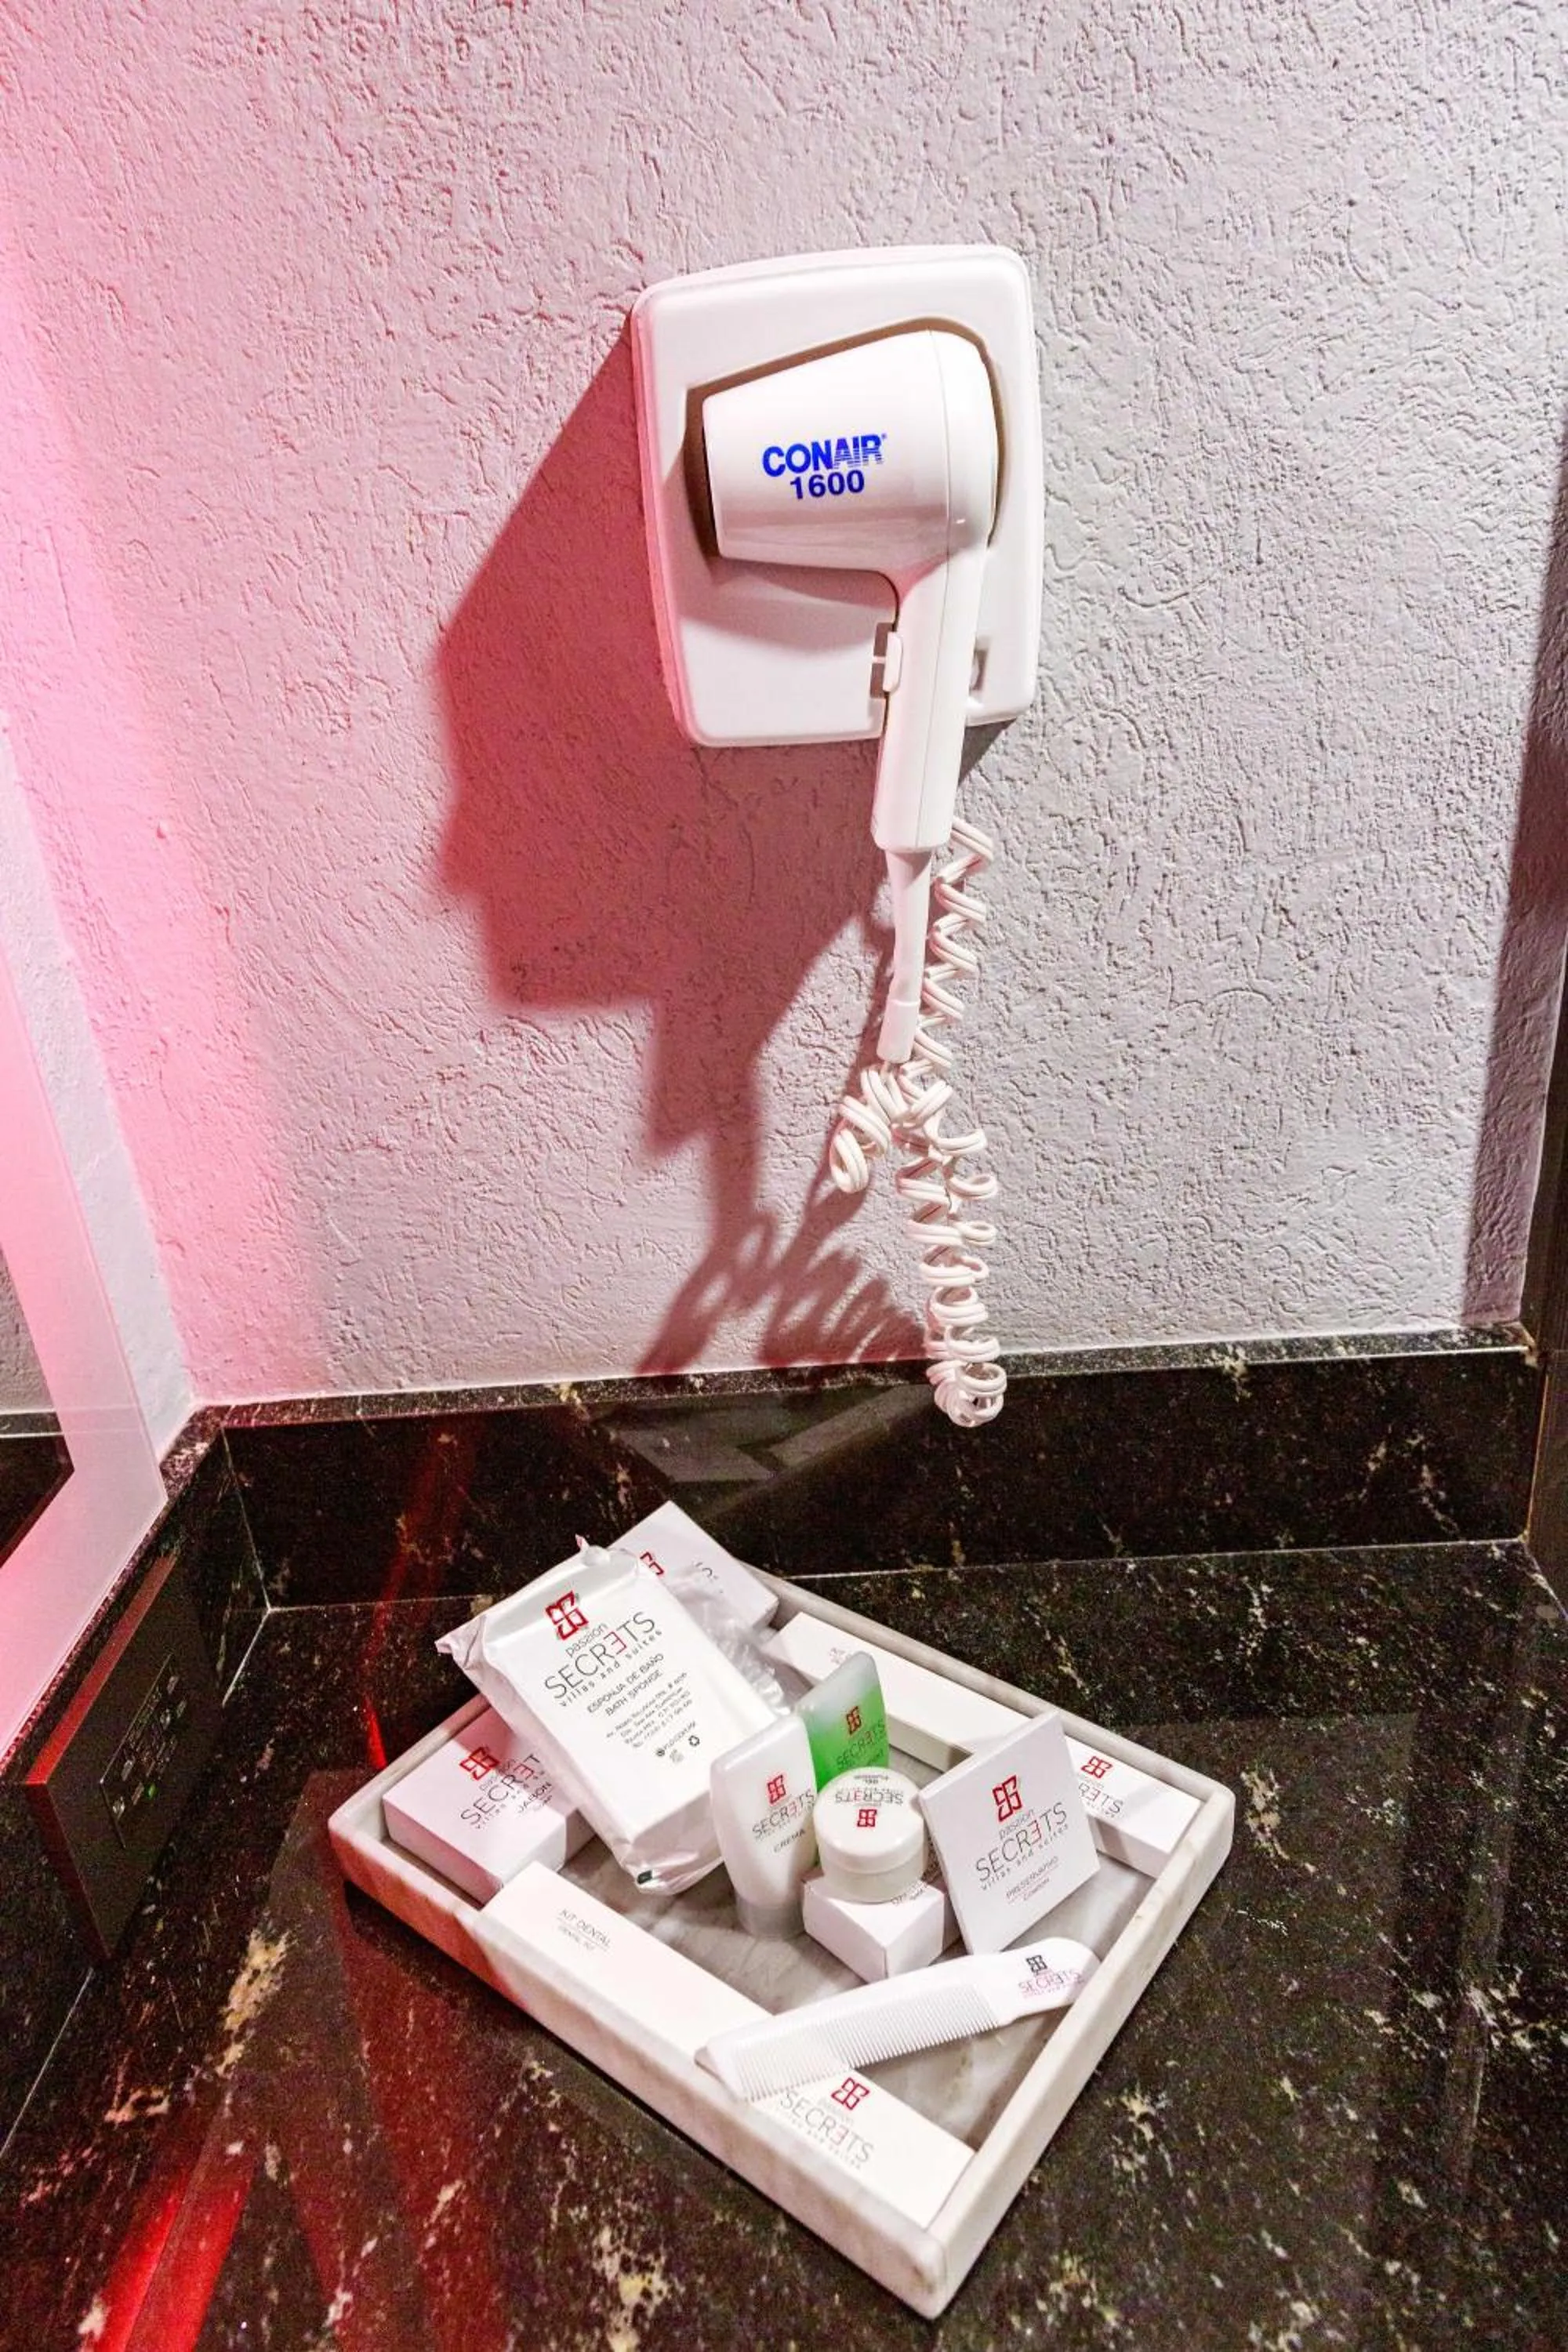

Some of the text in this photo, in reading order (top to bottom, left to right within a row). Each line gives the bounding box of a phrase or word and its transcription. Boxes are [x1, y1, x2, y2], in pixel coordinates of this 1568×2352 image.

[761, 434, 885, 477] CONAIR
[789, 470, 866, 499] 1600
[560, 1630, 662, 1707] villas and suites
[586, 1683, 626, 1713] ESPONJA
[626, 1671, 640, 1685] DE
[604, 1669, 663, 1716] BATH SPONGE
